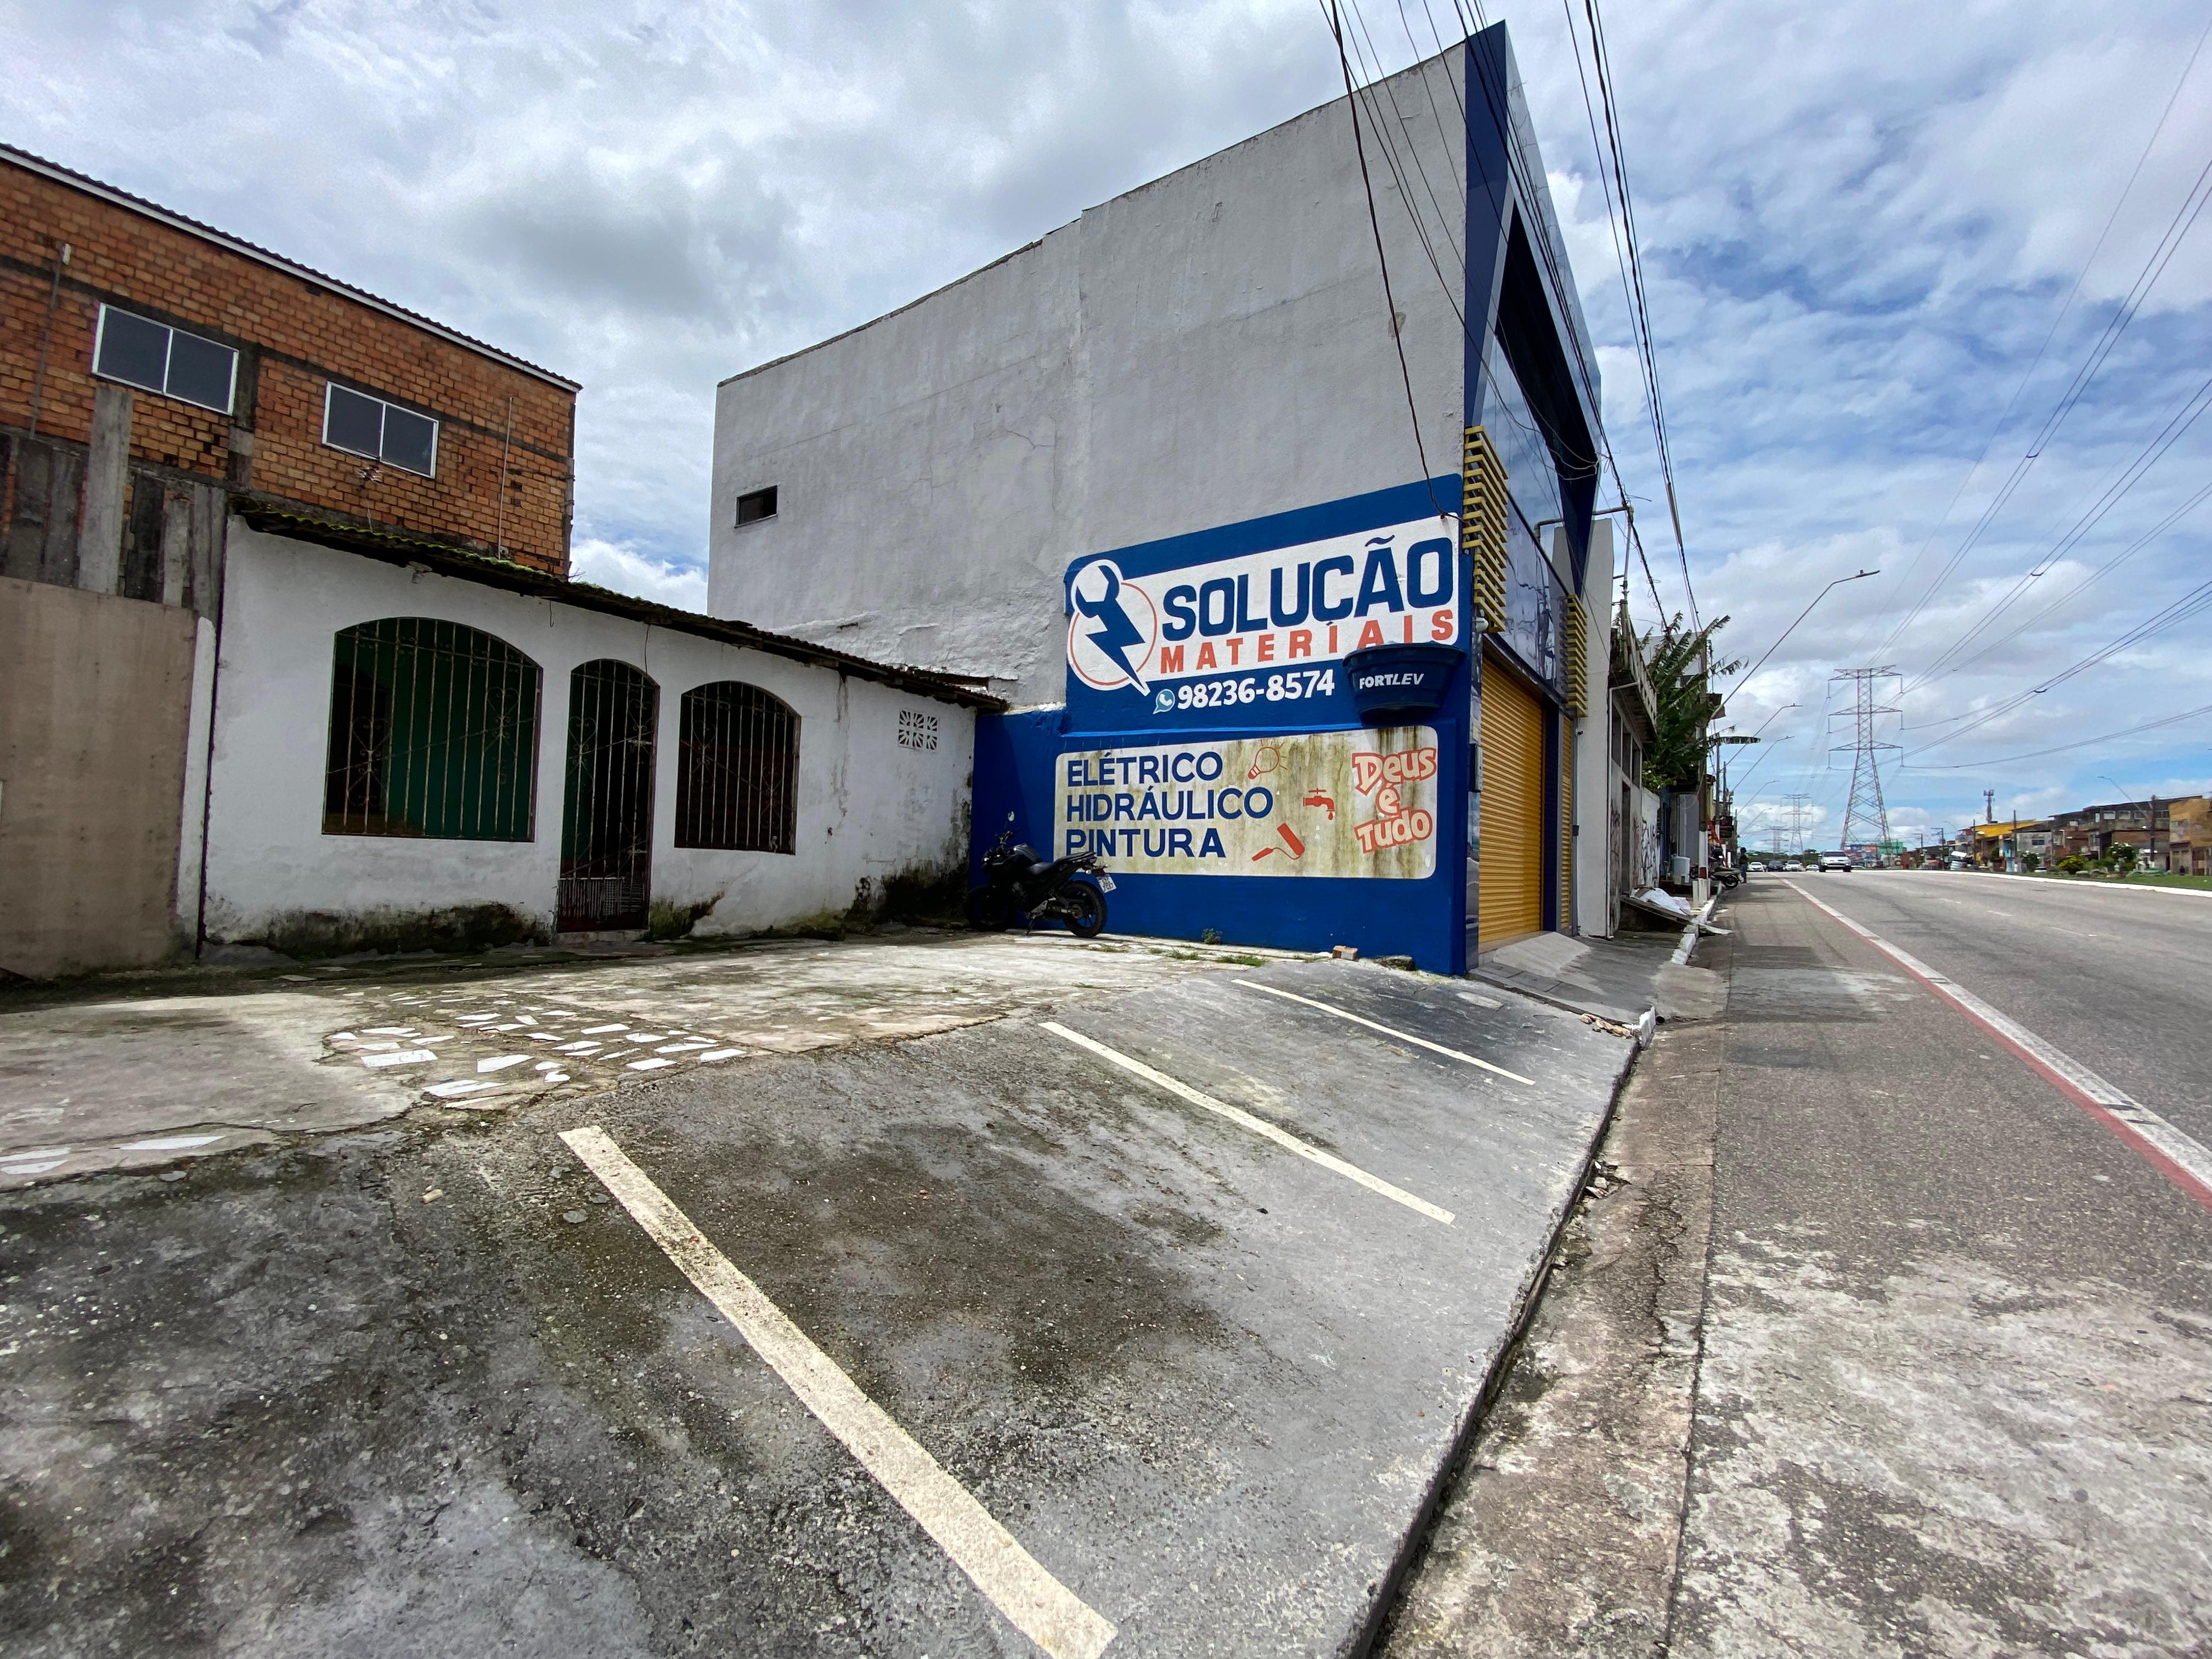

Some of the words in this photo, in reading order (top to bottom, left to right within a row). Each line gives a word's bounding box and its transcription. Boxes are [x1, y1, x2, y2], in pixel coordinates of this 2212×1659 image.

[1162, 534, 1453, 642] SOLUÇÃO
[1160, 610, 1453, 674] MATERIAIS
[1178, 669, 1335, 710] 98236-8574
[1359, 673, 1424, 689] FORTLEV
[1068, 751, 1223, 787] ELÉTRICO
[1067, 785, 1273, 822] HIDRÁULICO
[1066, 828, 1226, 859] PINTURA
